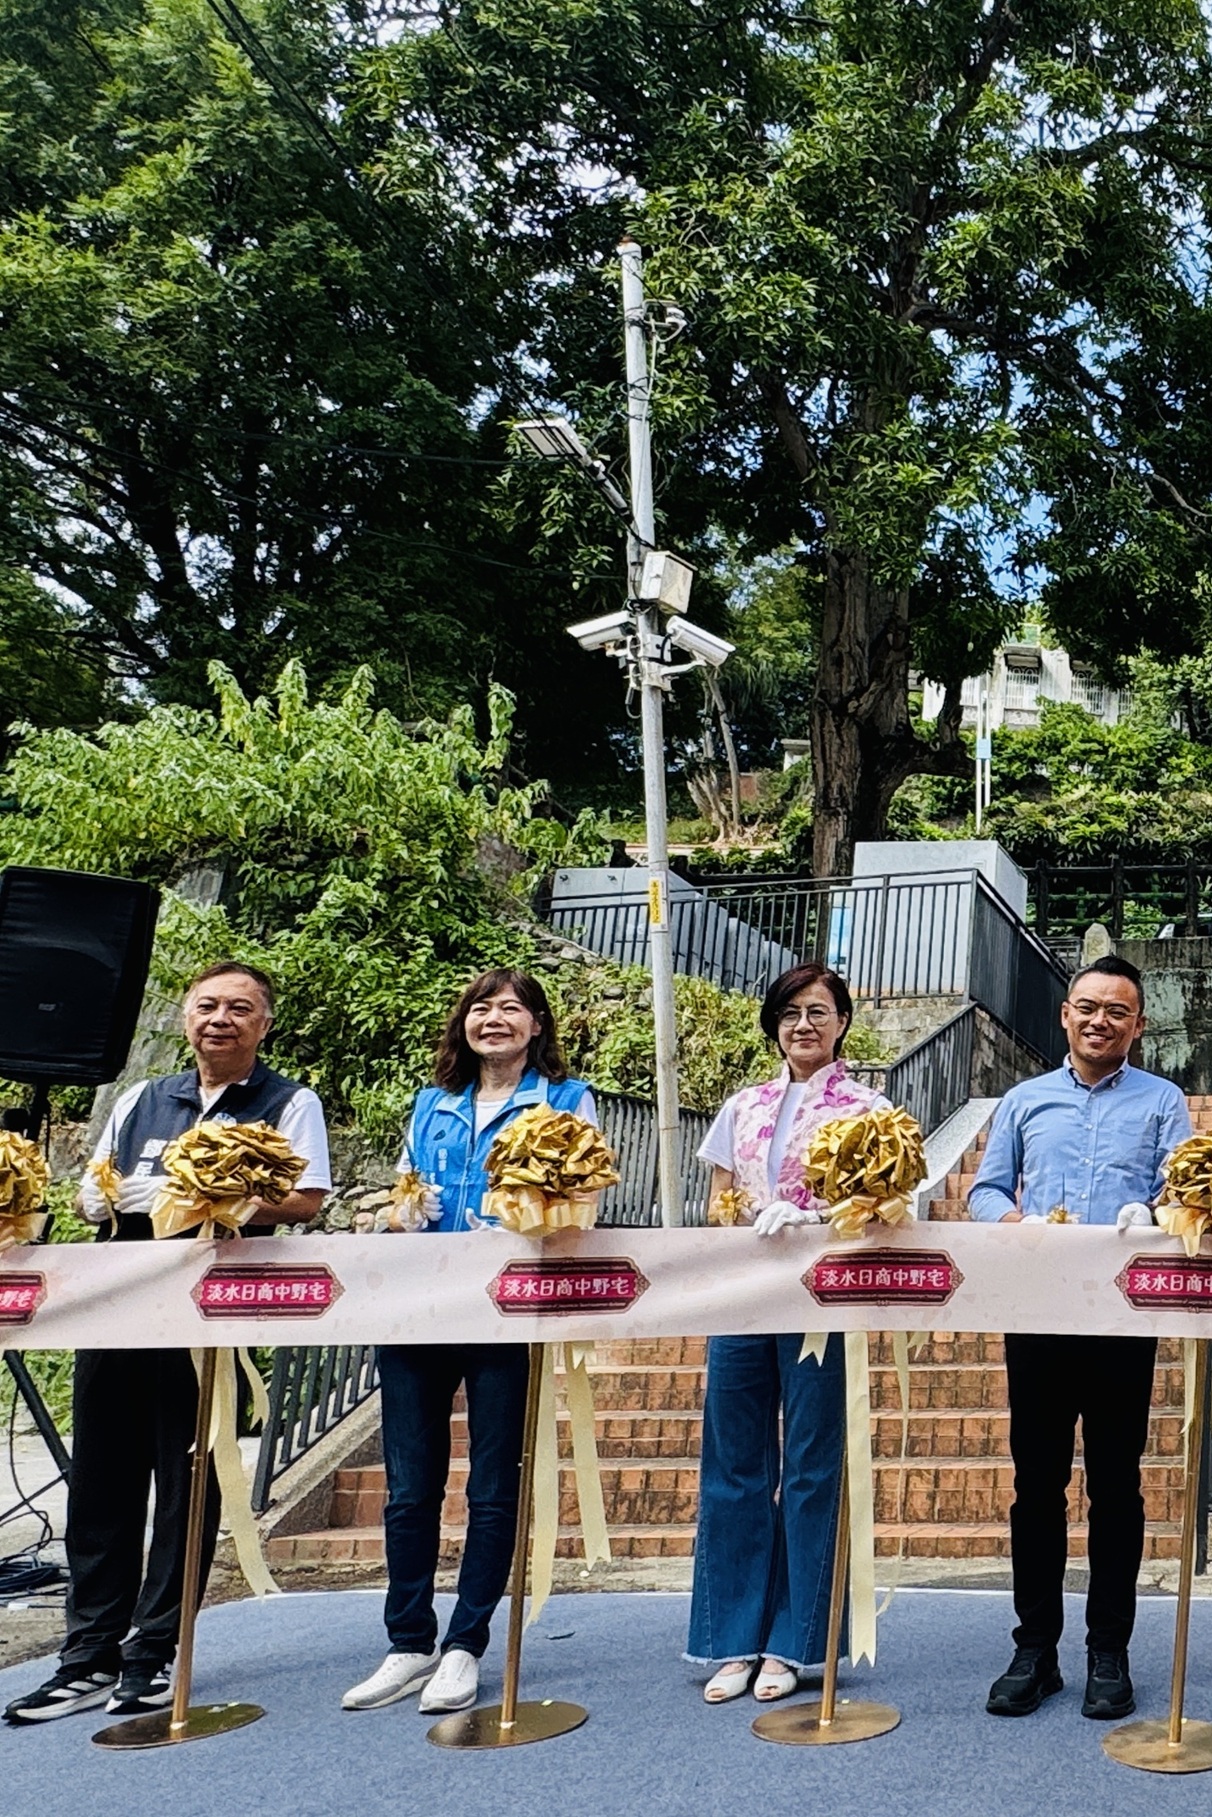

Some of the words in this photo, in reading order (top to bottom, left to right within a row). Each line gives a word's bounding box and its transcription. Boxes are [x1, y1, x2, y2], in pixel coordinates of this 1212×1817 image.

[503, 1276, 630, 1298] 淡水日商中野宅
[820, 1267, 945, 1288] 淡水日商中野宅
[0, 1289, 33, 1308] 野宅
[207, 1282, 327, 1302] 淡水日商中野宅
